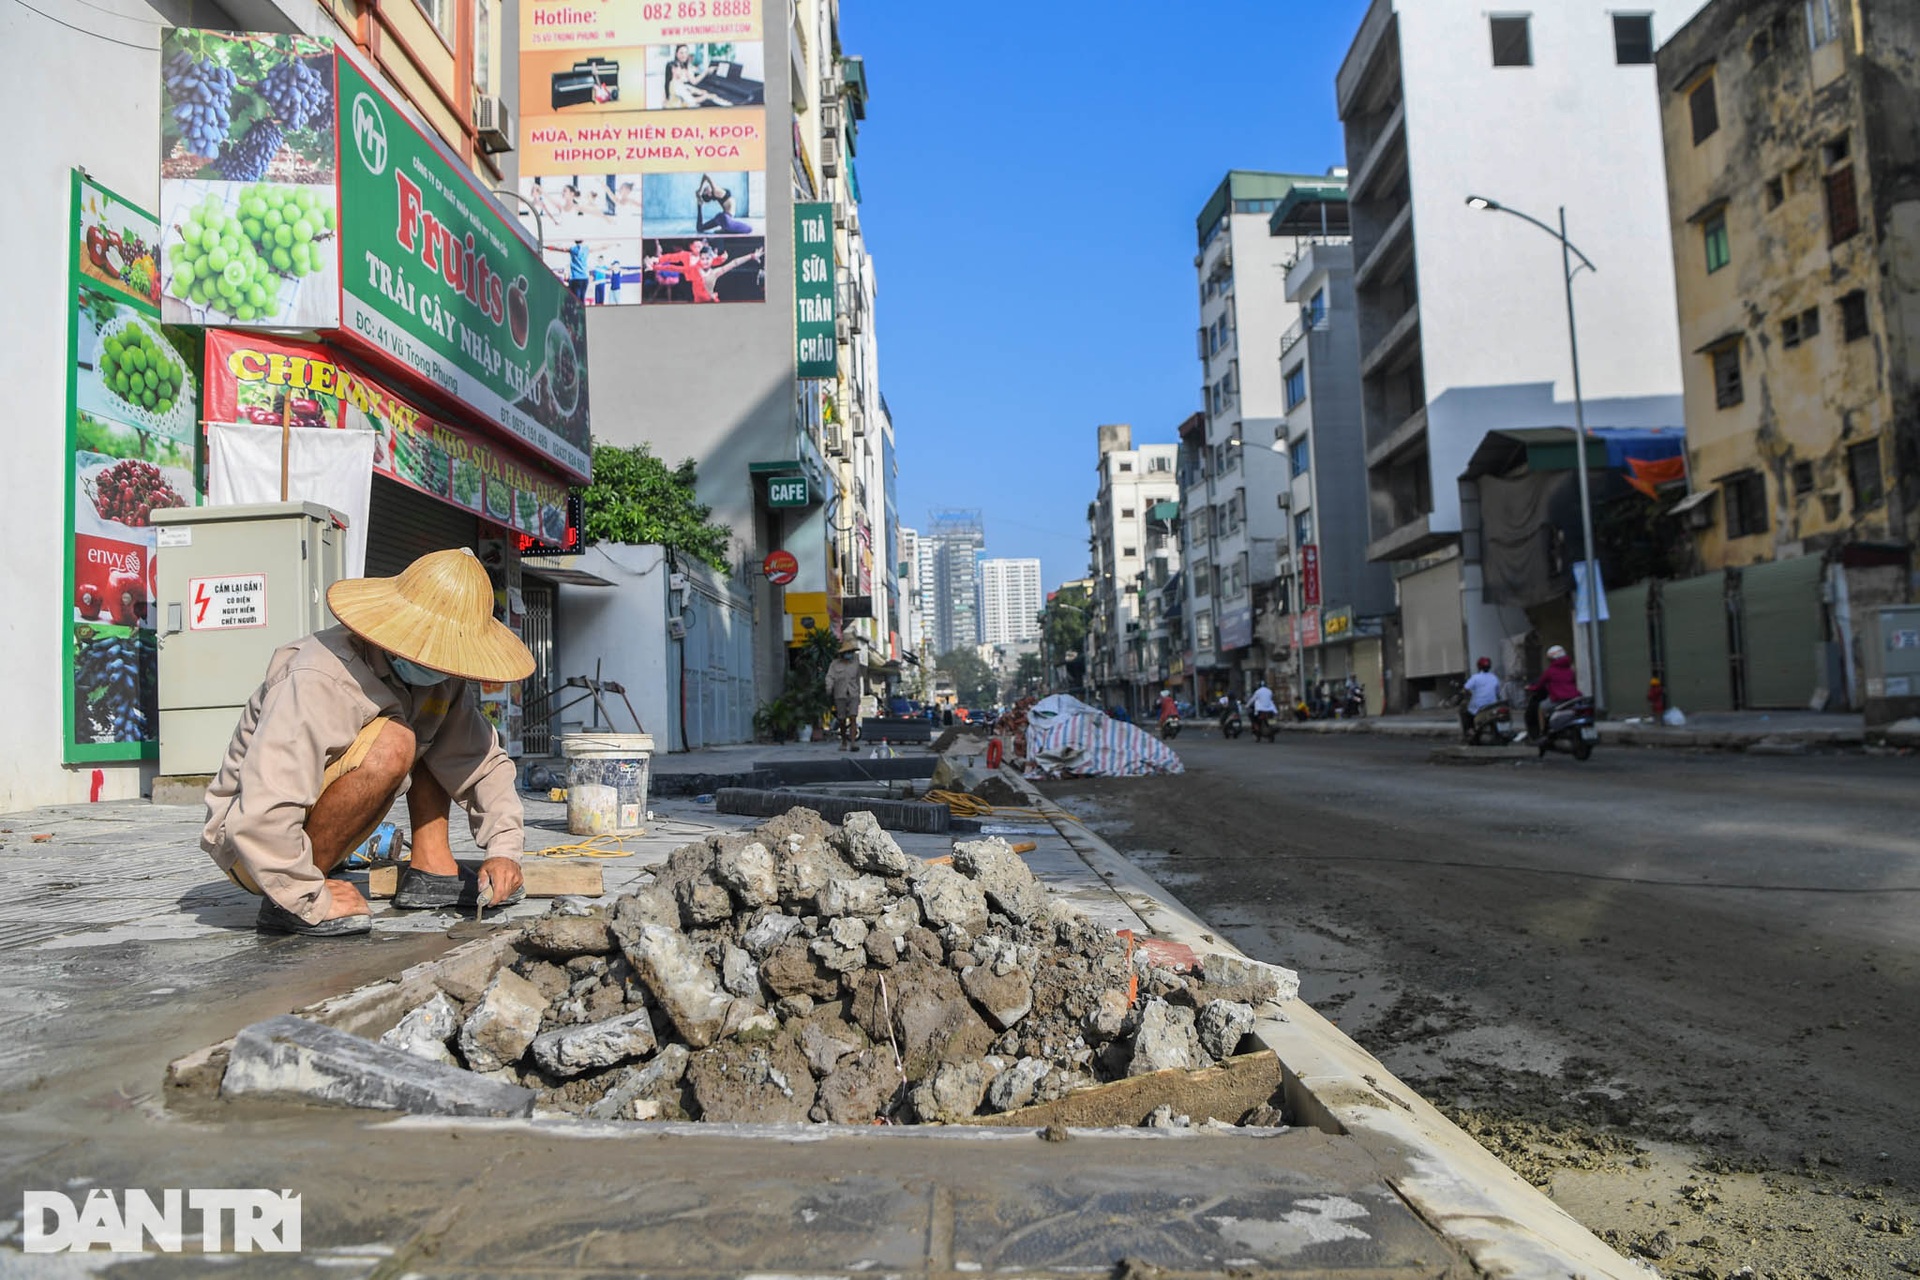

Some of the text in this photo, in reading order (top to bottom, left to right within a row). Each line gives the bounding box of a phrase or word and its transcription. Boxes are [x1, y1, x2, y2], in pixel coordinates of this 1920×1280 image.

[534, 0, 751, 25] Hotline: 082 863 8888
[628, 123, 666, 141] HIỆN
[709, 125, 759, 140] KPOP,
[554, 145, 740, 162] HIPHOP, ZUMBA, YOGA
[801, 214, 826, 243] TRÀ
[395, 167, 504, 327] Fruits
[802, 254, 827, 283] SỮA
[799, 293, 832, 323] TRÂN
[356, 310, 375, 338] ĐC:
[377, 325, 388, 347] 41
[406, 343, 431, 377] Trọng
[432, 361, 458, 395] Phụng
[420, 294, 456, 343] CÂY
[460, 322, 501, 377] NHẬP
[504, 360, 541, 406] KHẨU
[800, 333, 833, 363] CHÂU
[432, 422, 468, 463] NHO
[771, 483, 805, 501] CAFE
[88, 547, 126, 573] envy
[214, 581, 230, 593] CẤM
[232, 583, 242, 594] LẠI
